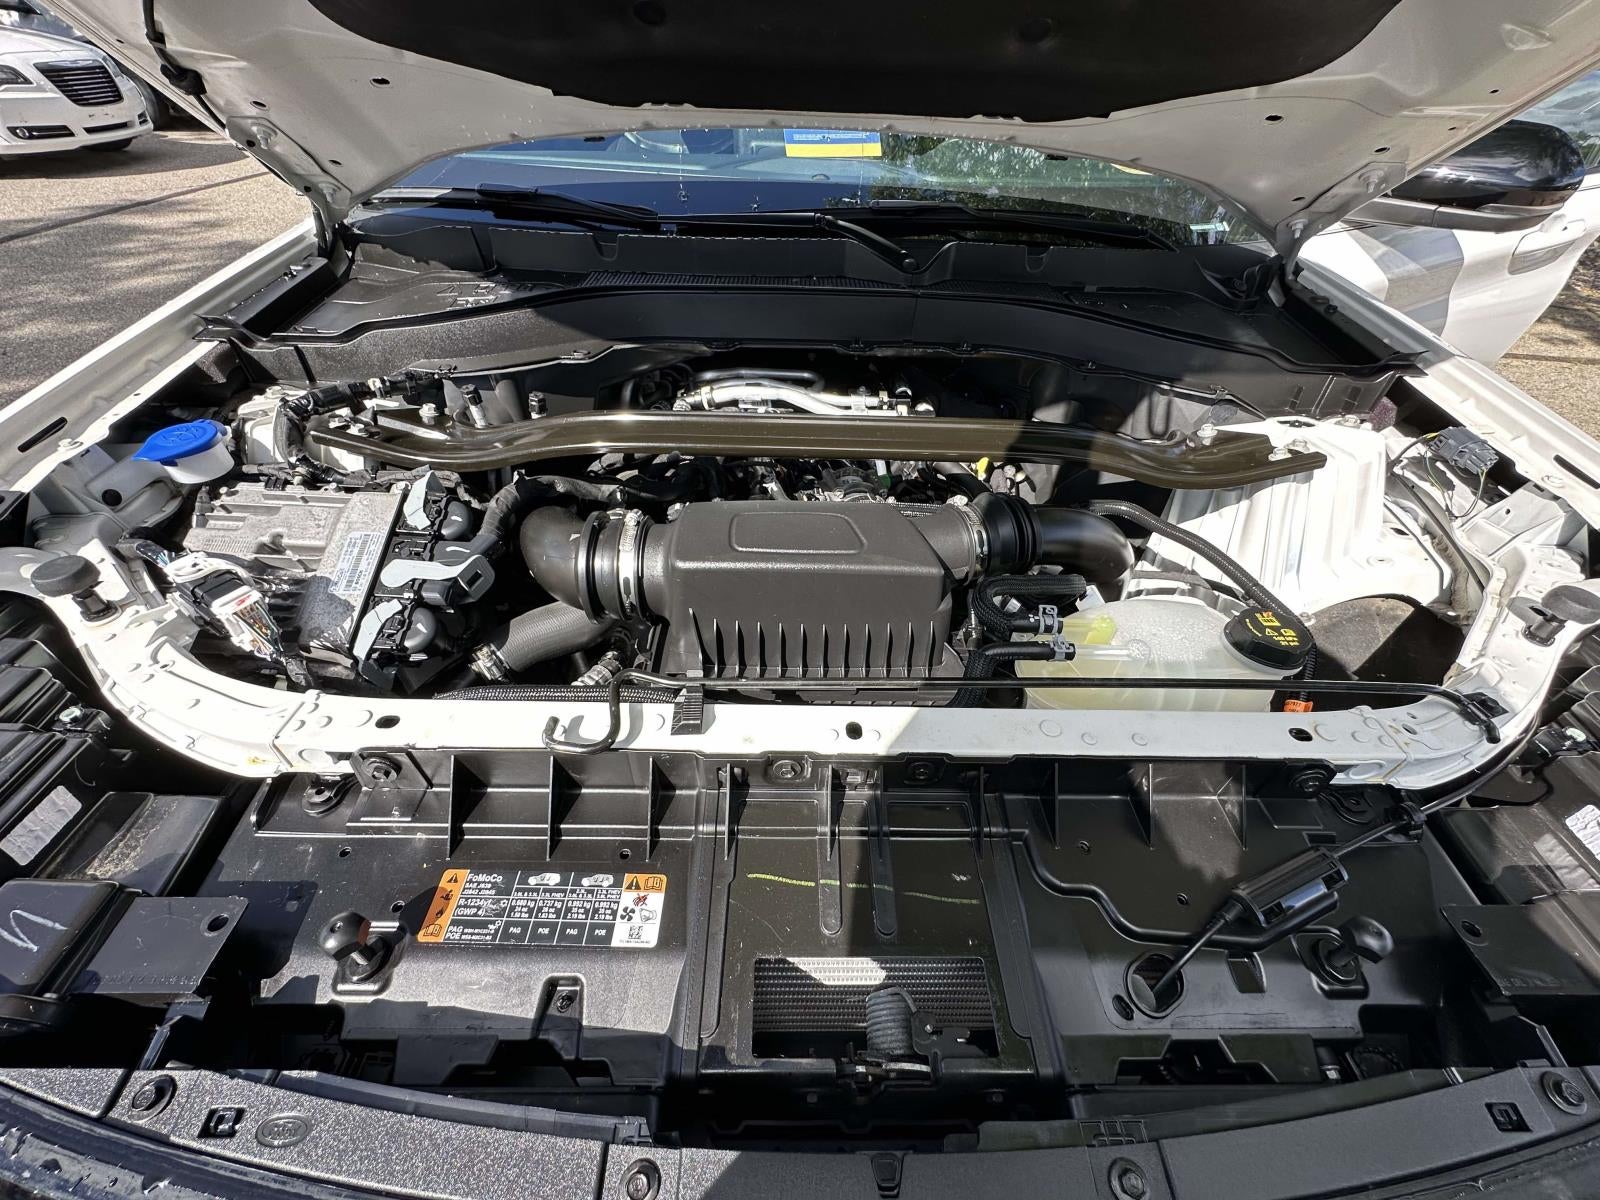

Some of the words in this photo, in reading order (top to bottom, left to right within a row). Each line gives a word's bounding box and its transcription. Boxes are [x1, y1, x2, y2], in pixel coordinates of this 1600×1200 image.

[467, 873, 503, 882] FoMoCo
[458, 898, 491, 908] R-1234yf
[527, 900, 535, 908] kg
[554, 900, 562, 908] kg
[583, 901, 591, 909] kg
[610, 902, 618, 910] kg
[455, 907, 478, 917] (GWP
[477, 907, 486, 917] 4)
[448, 925, 463, 933] PAG
